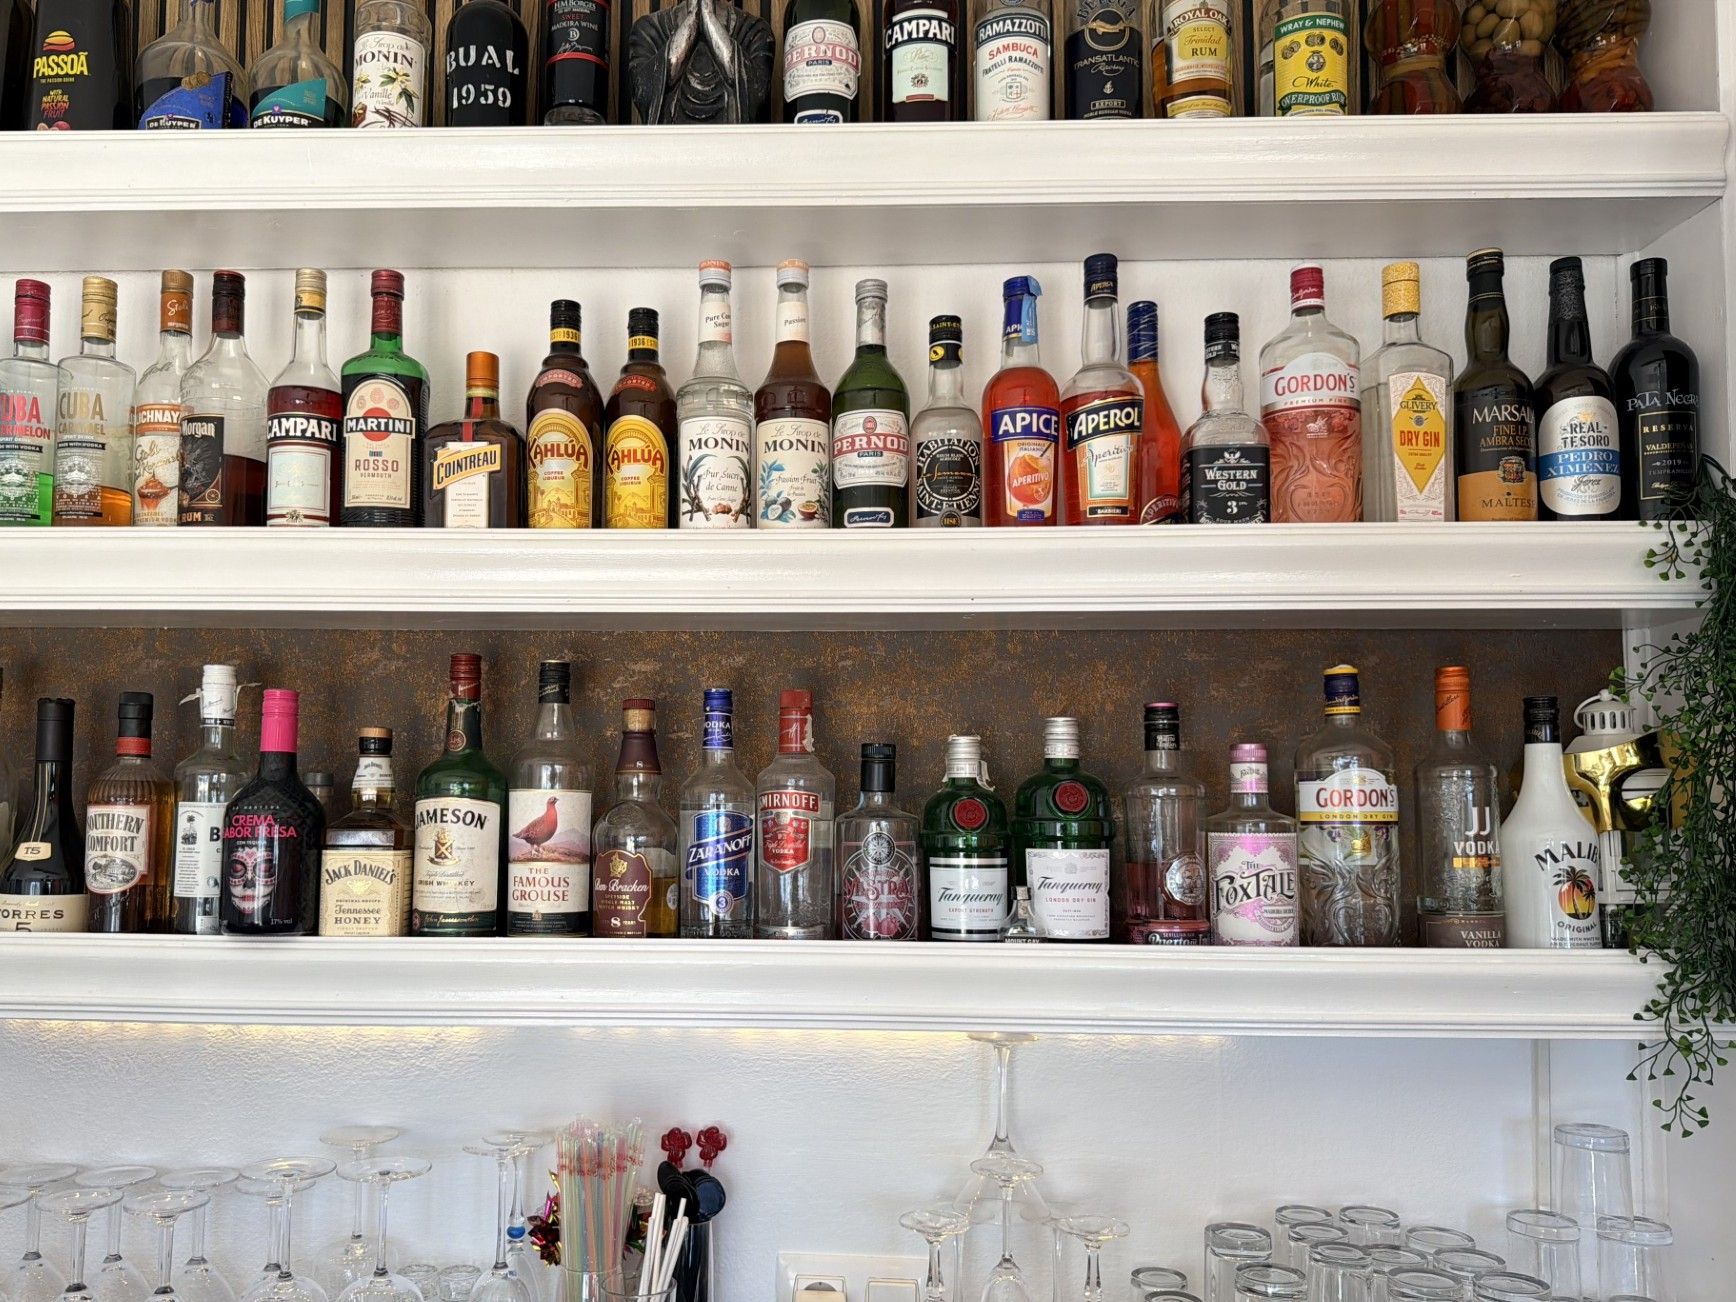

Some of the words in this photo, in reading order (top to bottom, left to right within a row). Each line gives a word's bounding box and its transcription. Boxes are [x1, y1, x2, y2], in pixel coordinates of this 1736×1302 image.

[551, 19, 580, 31] MADEIRA
[1173, 9, 1207, 27] ROYAL
[1280, 20, 1305, 33] WRAY
[1305, 19, 1314, 27] &
[1316, 18, 1345, 32] NEPHEW
[886, 19, 956, 48] CAMPARI
[979, 19, 1049, 43] RAMAZZOTTI
[988, 42, 1039, 60] SAMBUCA
[1191, 47, 1217, 57] RUM
[33, 51, 90, 79] PASSOÃ
[447, 44, 520, 76] BUAL
[982, 58, 1007, 76] FRATELLI
[1292, 76, 1338, 89] White
[453, 83, 512, 109] 1959
[1280, 93, 1332, 110] OVERPROOF
[253, 120, 262, 129] DE
[262, 114, 308, 127] KUYPER
[1274, 373, 1356, 397] GORDON'S
[59, 391, 107, 421] CUBA
[1626, 390, 1662, 412] PATA
[267, 417, 338, 442] CAMPARI
[347, 418, 411, 434] MARTINI
[998, 410, 1058, 437] APICE
[1073, 407, 1141, 440] APEROL
[1493, 424, 1516, 436] FINE
[1569, 421, 1603, 435] REAL
[688, 437, 750, 456] MONIN
[833, 434, 907, 456] PERNOD
[1399, 430, 1420, 447] DRY
[1422, 430, 1440, 447] GIN
[1479, 435, 1515, 448] AMBRA
[1560, 435, 1610, 448] TESORO
[528, 438, 591, 471] KAHLÚA
[764, 440, 827, 456] MONIN
[354, 459, 400, 473] ROSSO
[606, 445, 666, 477] KAHLÚA
[1557, 450, 1614, 465] PEDRO
[437, 449, 498, 485] COINTREAU
[1205, 469, 1258, 481] WESTERN
[1217, 480, 1248, 491] GOLD
[1226, 500, 1238, 514] 3
[1315, 787, 1395, 809] GORDON'S
[231, 815, 276, 826] CREMA
[416, 808, 488, 831] JAMESON
[1465, 806, 1491, 836] JJ
[255, 826, 297, 838] FRESA
[689, 835, 752, 864] ZARANOFF
[1453, 840, 1500, 857] VODKA
[325, 865, 351, 885] JACK
[353, 860, 396, 885] DANIEL'S
[529, 867, 550, 875] THE
[706, 867, 741, 877] VODKA
[513, 875, 571, 889] FAMOUS
[1037, 876, 1104, 895] Tanqueray
[511, 889, 570, 903] GROUSE
[717, 897, 727, 908] 3
[938, 887, 1005, 906] Tanqueray
[0, 908, 65, 920] ORRES
[334, 904, 382, 915] Tennessee
[334, 916, 382, 925] HONEY
[610, 916, 621, 928] 8
